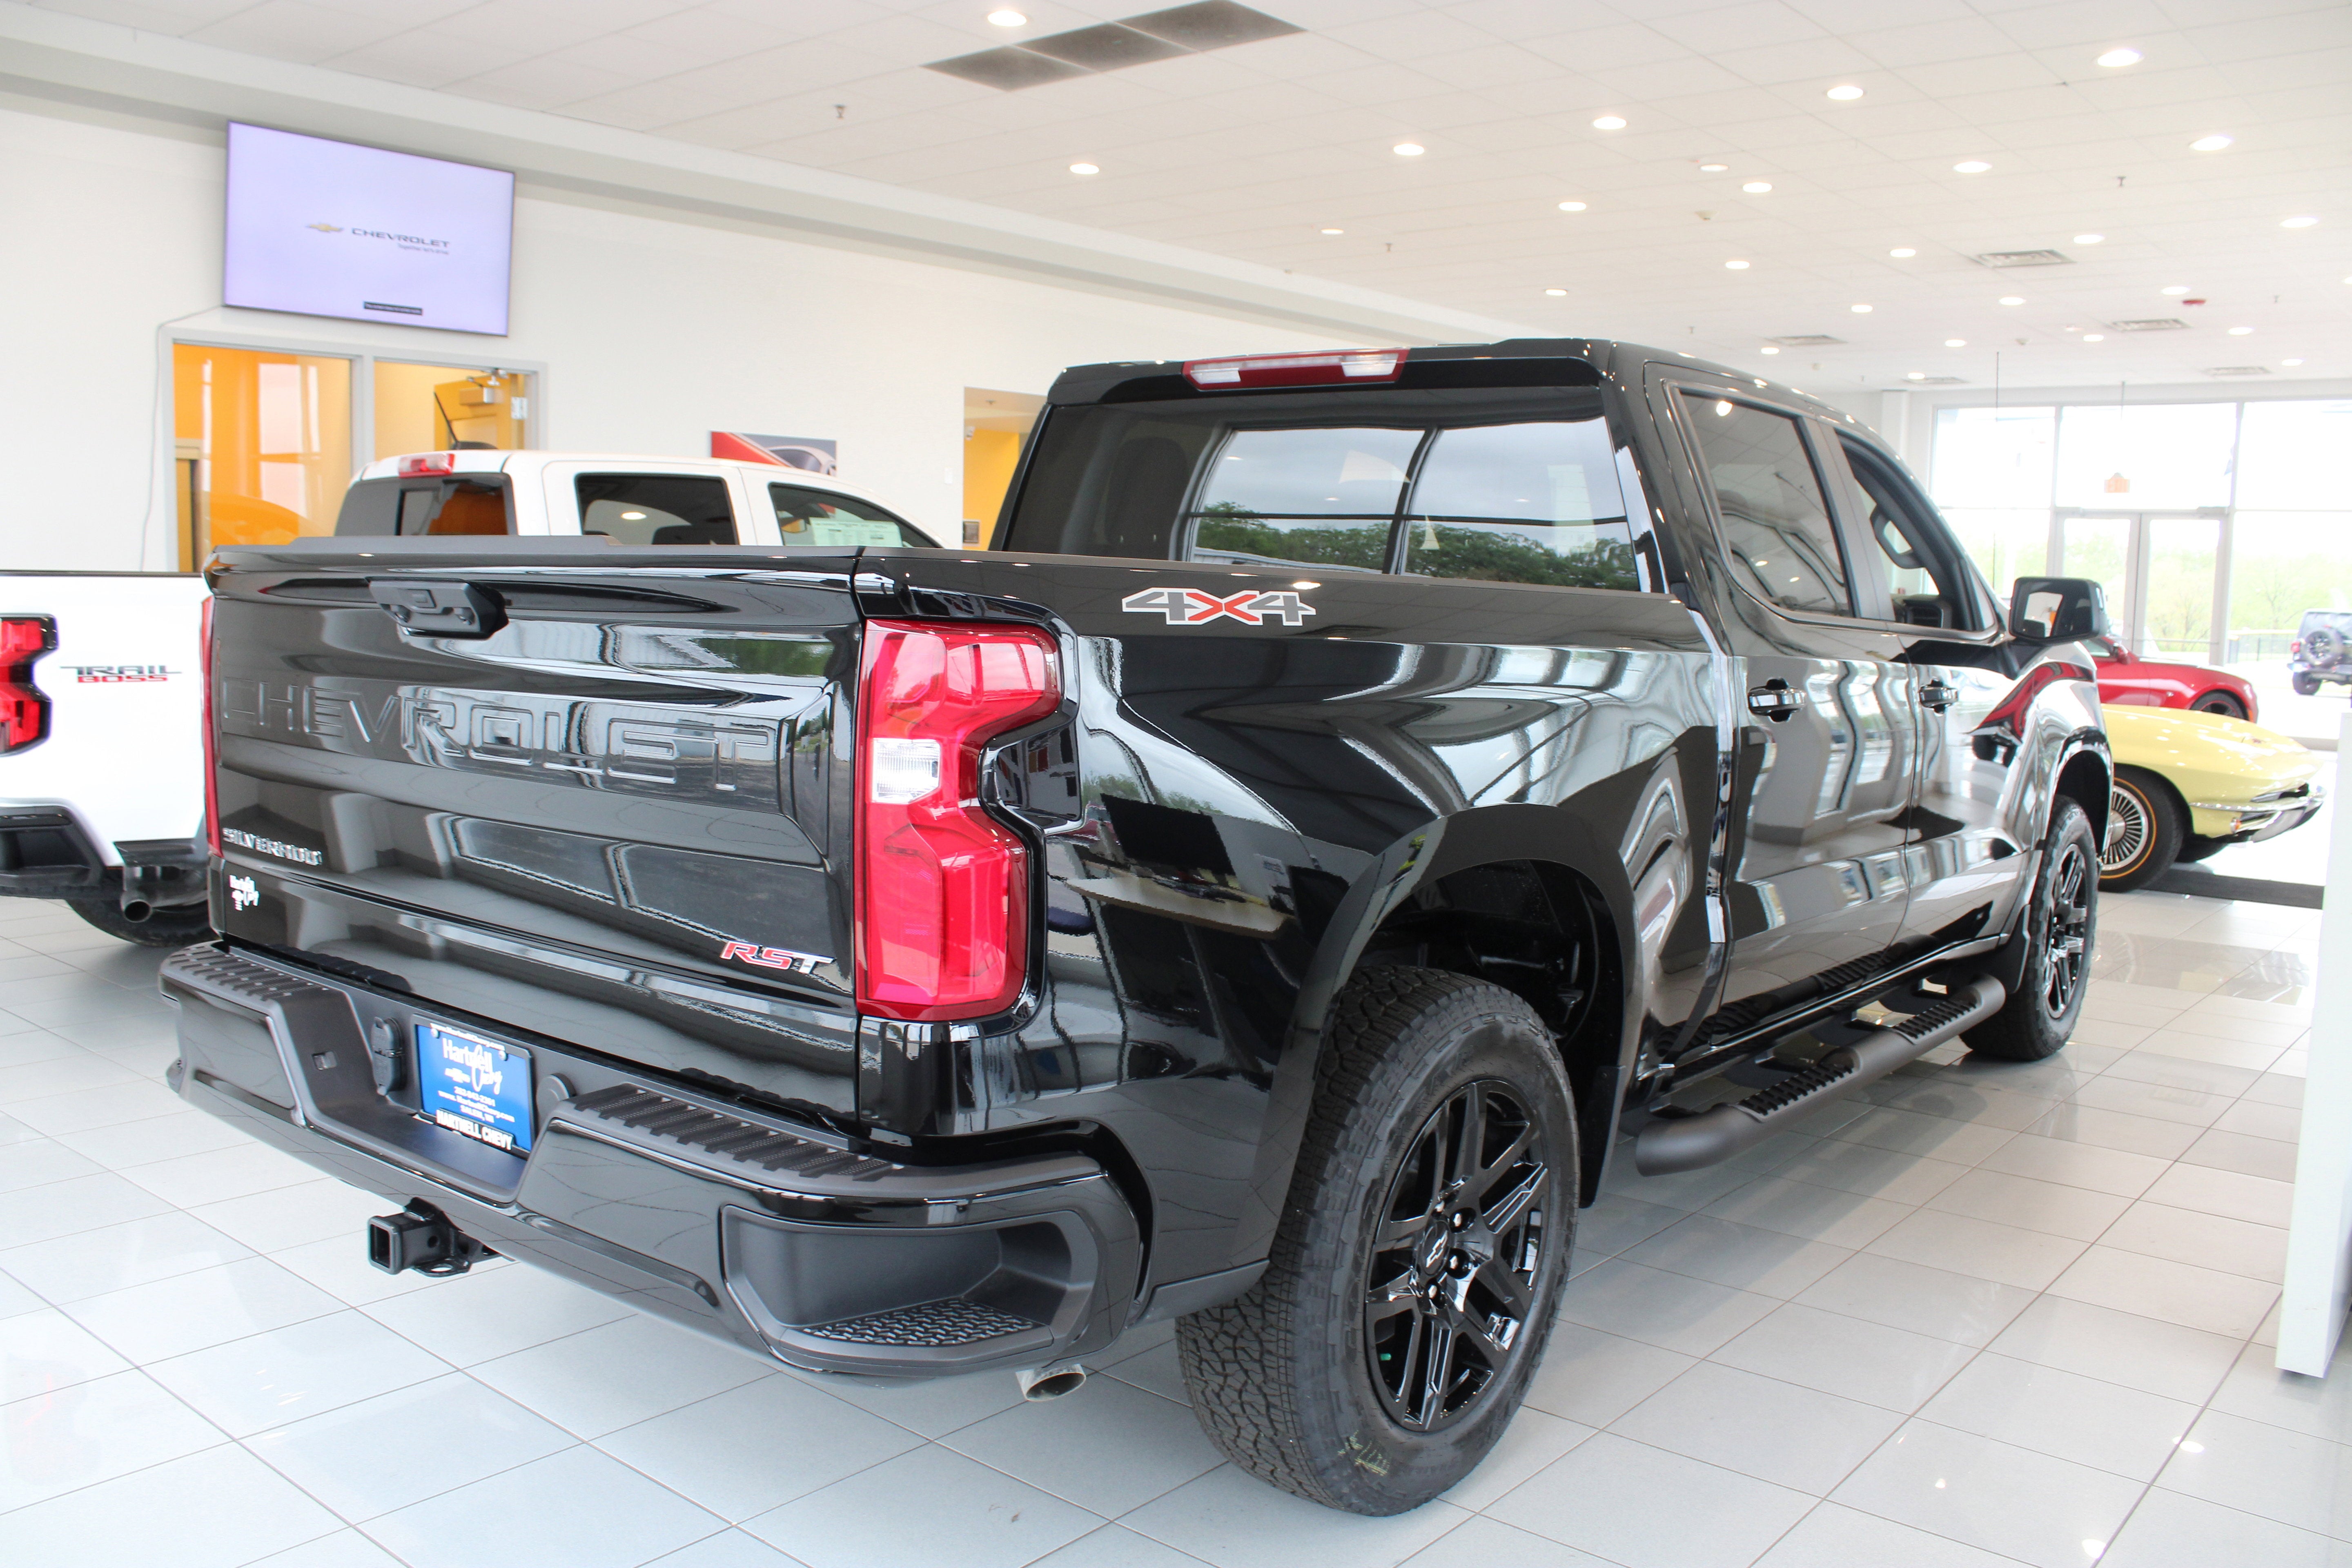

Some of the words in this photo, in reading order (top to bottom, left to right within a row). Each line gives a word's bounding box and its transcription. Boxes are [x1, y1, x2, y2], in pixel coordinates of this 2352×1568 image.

[352, 227, 450, 247] CHEVROLET
[60, 665, 182, 675] TRAIL
[222, 676, 774, 791] CHEVROLET
[223, 828, 322, 866] SILVERADO
[719, 941, 834, 974] RST
[442, 1038, 493, 1073] Hartnell
[436, 1109, 482, 1139] HARTNELL
[481, 1126, 513, 1150] CHEVY
